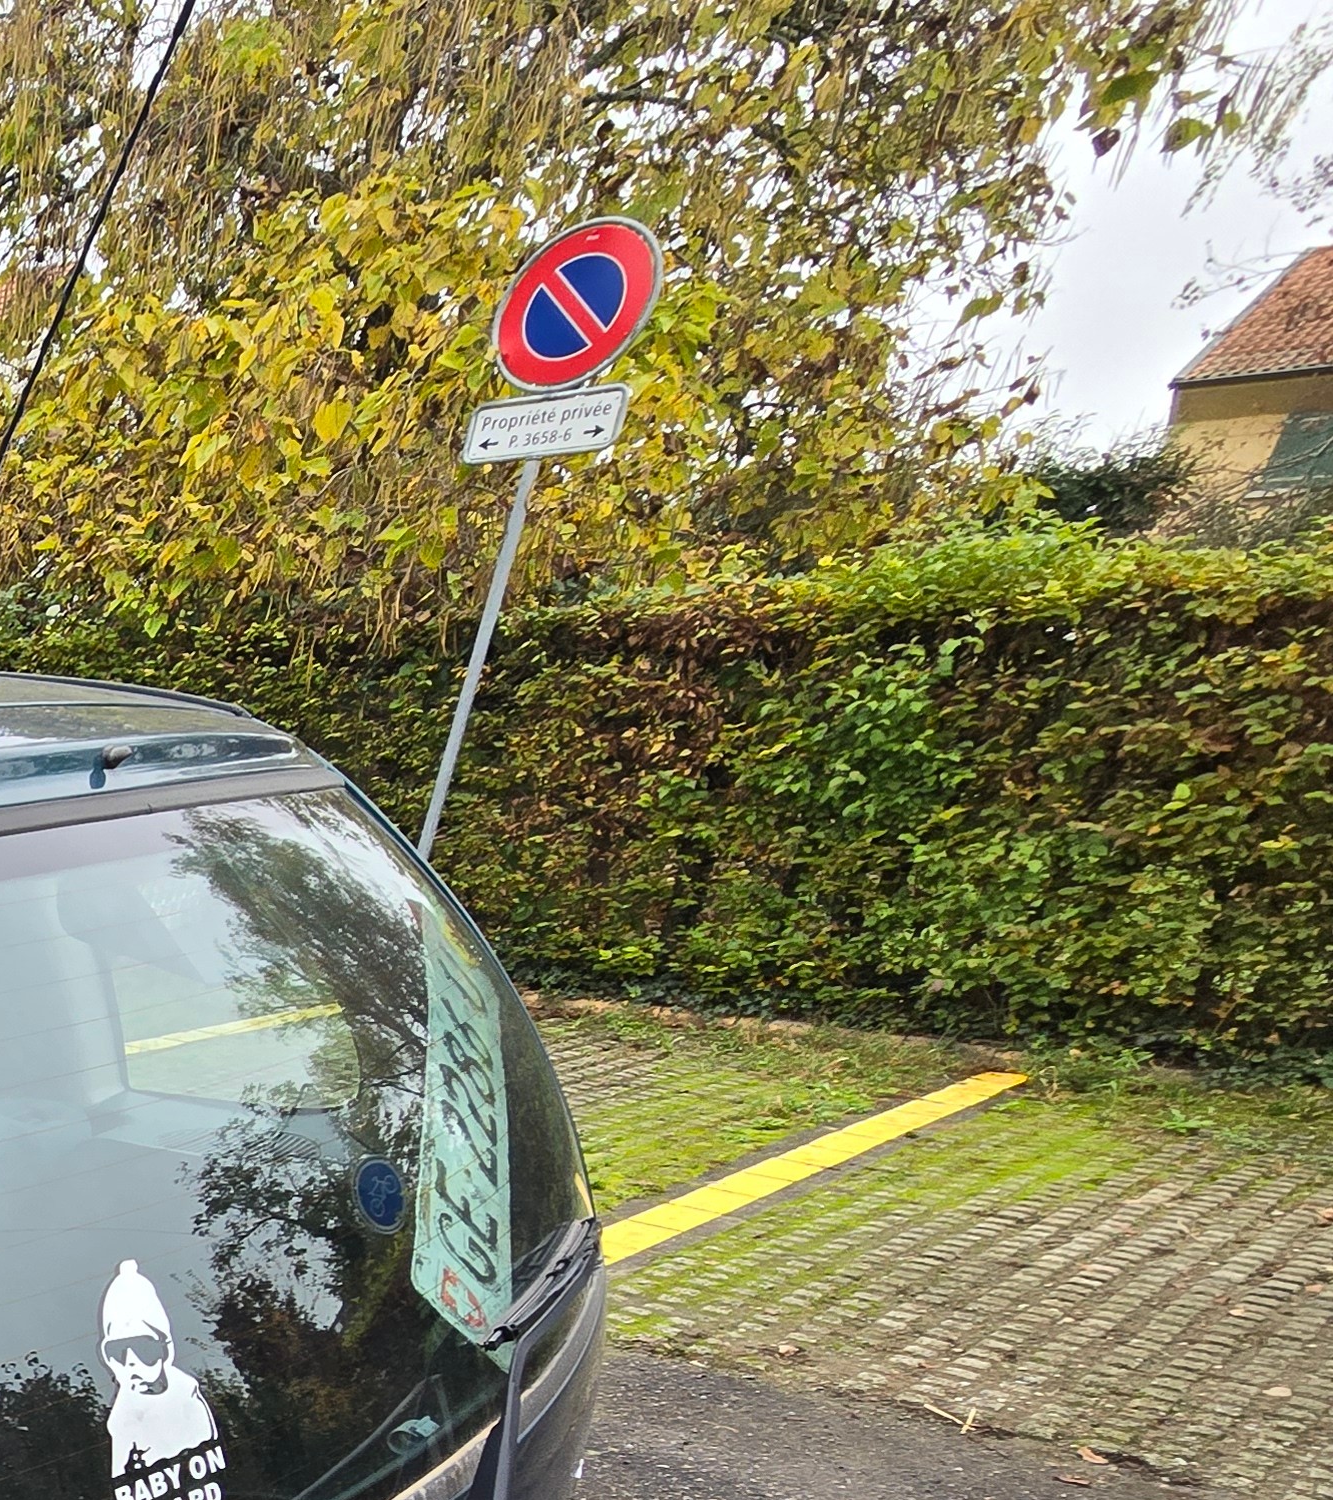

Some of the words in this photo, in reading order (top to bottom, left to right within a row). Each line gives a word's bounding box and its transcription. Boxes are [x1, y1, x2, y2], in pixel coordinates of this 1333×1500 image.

[481, 407, 556, 432] Propriété
[560, 401, 613, 426] privée
[522, 427, 572, 447] 3658-6
[188, 1445, 226, 1480] ON
